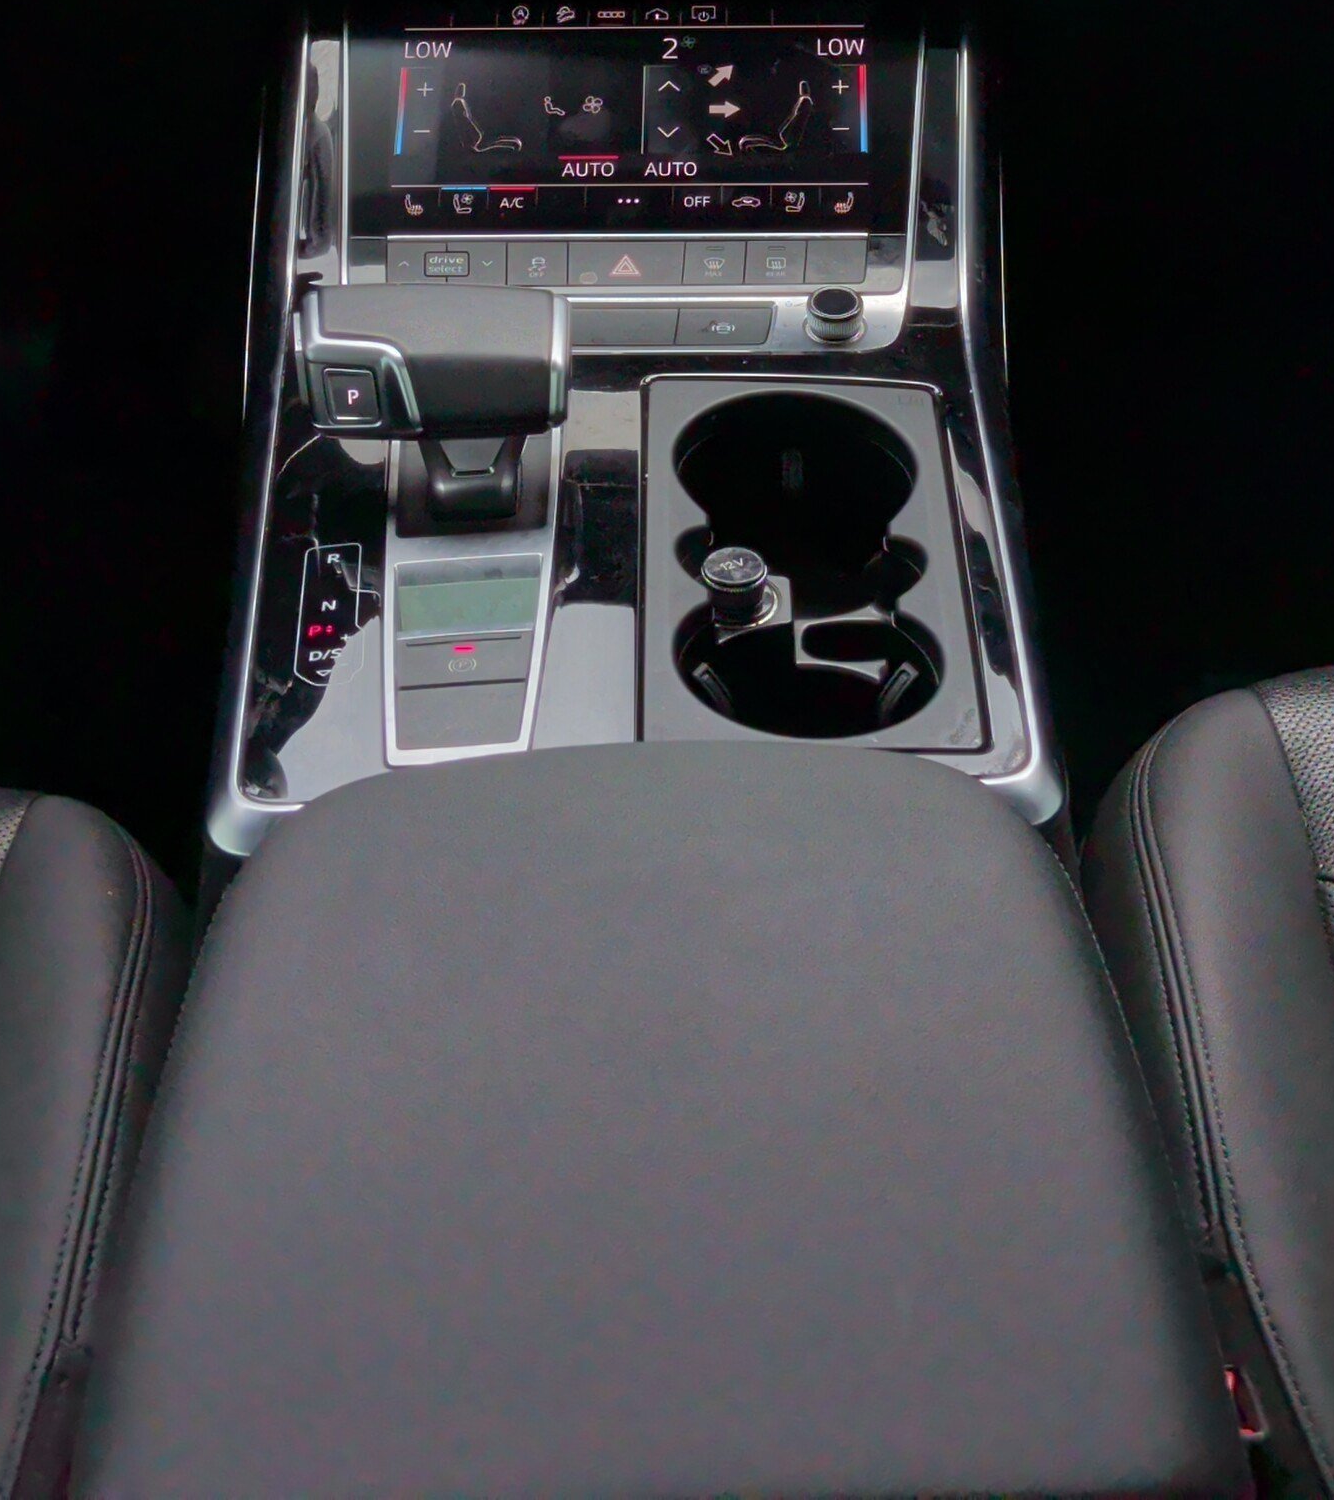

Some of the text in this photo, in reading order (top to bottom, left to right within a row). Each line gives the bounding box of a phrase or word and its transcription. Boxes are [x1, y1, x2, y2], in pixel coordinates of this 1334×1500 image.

[404, 41, 452, 59] LOW
[662, 38, 678, 59] 2
[817, 38, 865, 56] LOW
[561, 162, 614, 177] AUTO
[644, 161, 697, 177] AUTO
[499, 197, 524, 209] A/C
[683, 196, 710, 208] OFF
[429, 256, 464, 264] drive
[428, 264, 463, 273] select
[347, 389, 360, 405] P
[327, 553, 340, 564] R
[321, 600, 337, 612] N
[307, 625, 323, 637] P
[308, 649, 342, 662] D/S
